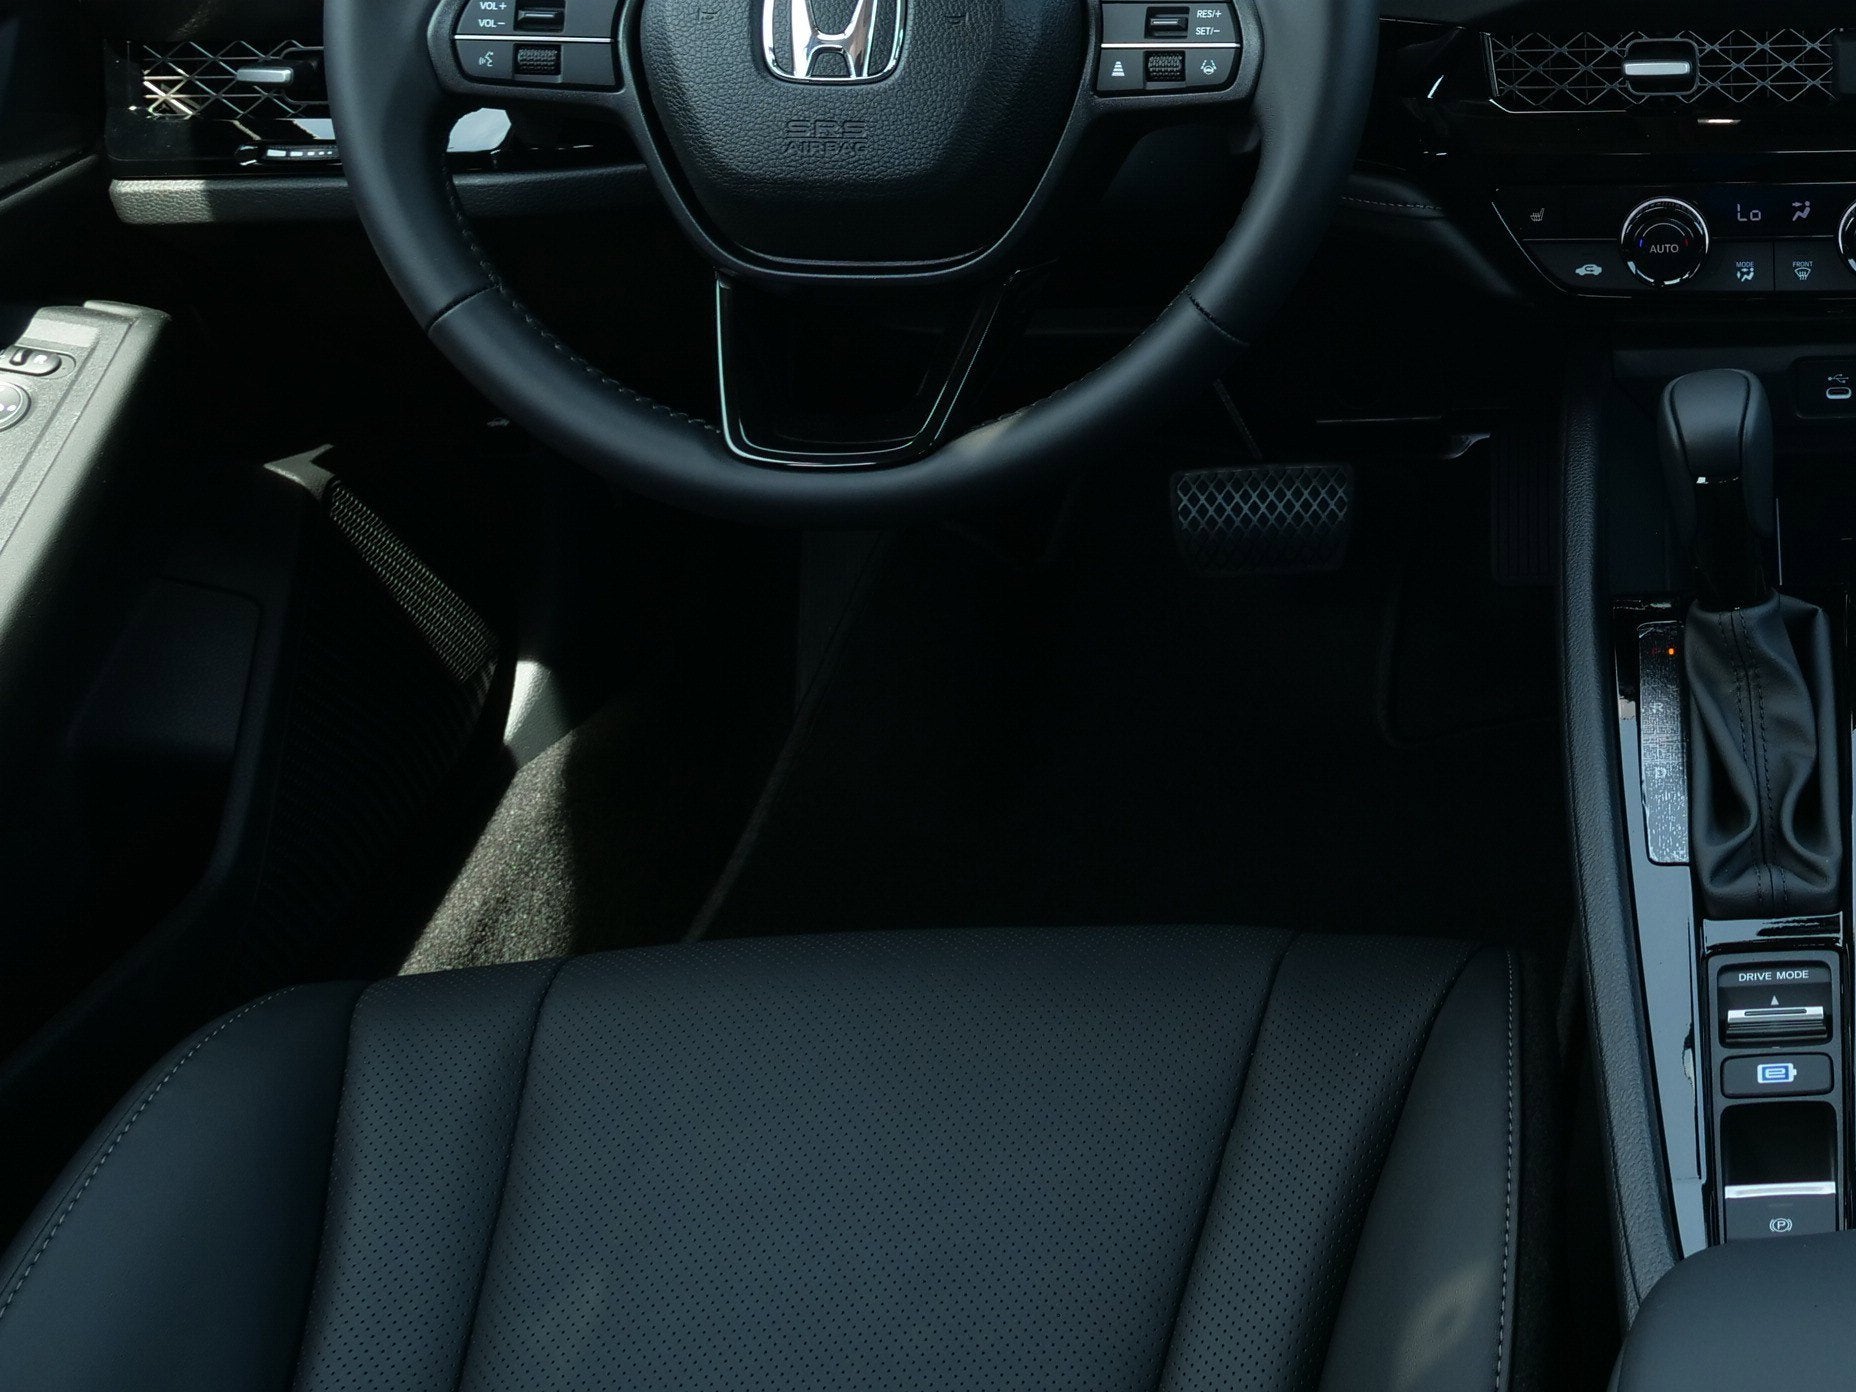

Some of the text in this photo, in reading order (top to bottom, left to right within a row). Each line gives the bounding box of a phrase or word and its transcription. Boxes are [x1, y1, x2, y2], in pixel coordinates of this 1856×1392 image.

[785, 119, 868, 138] SRS
[786, 141, 868, 155] AIRBAG
[1737, 203, 1761, 221] Lo
[1650, 244, 1679, 254] AUTO
[1739, 970, 1809, 981] DRIVE MODE
